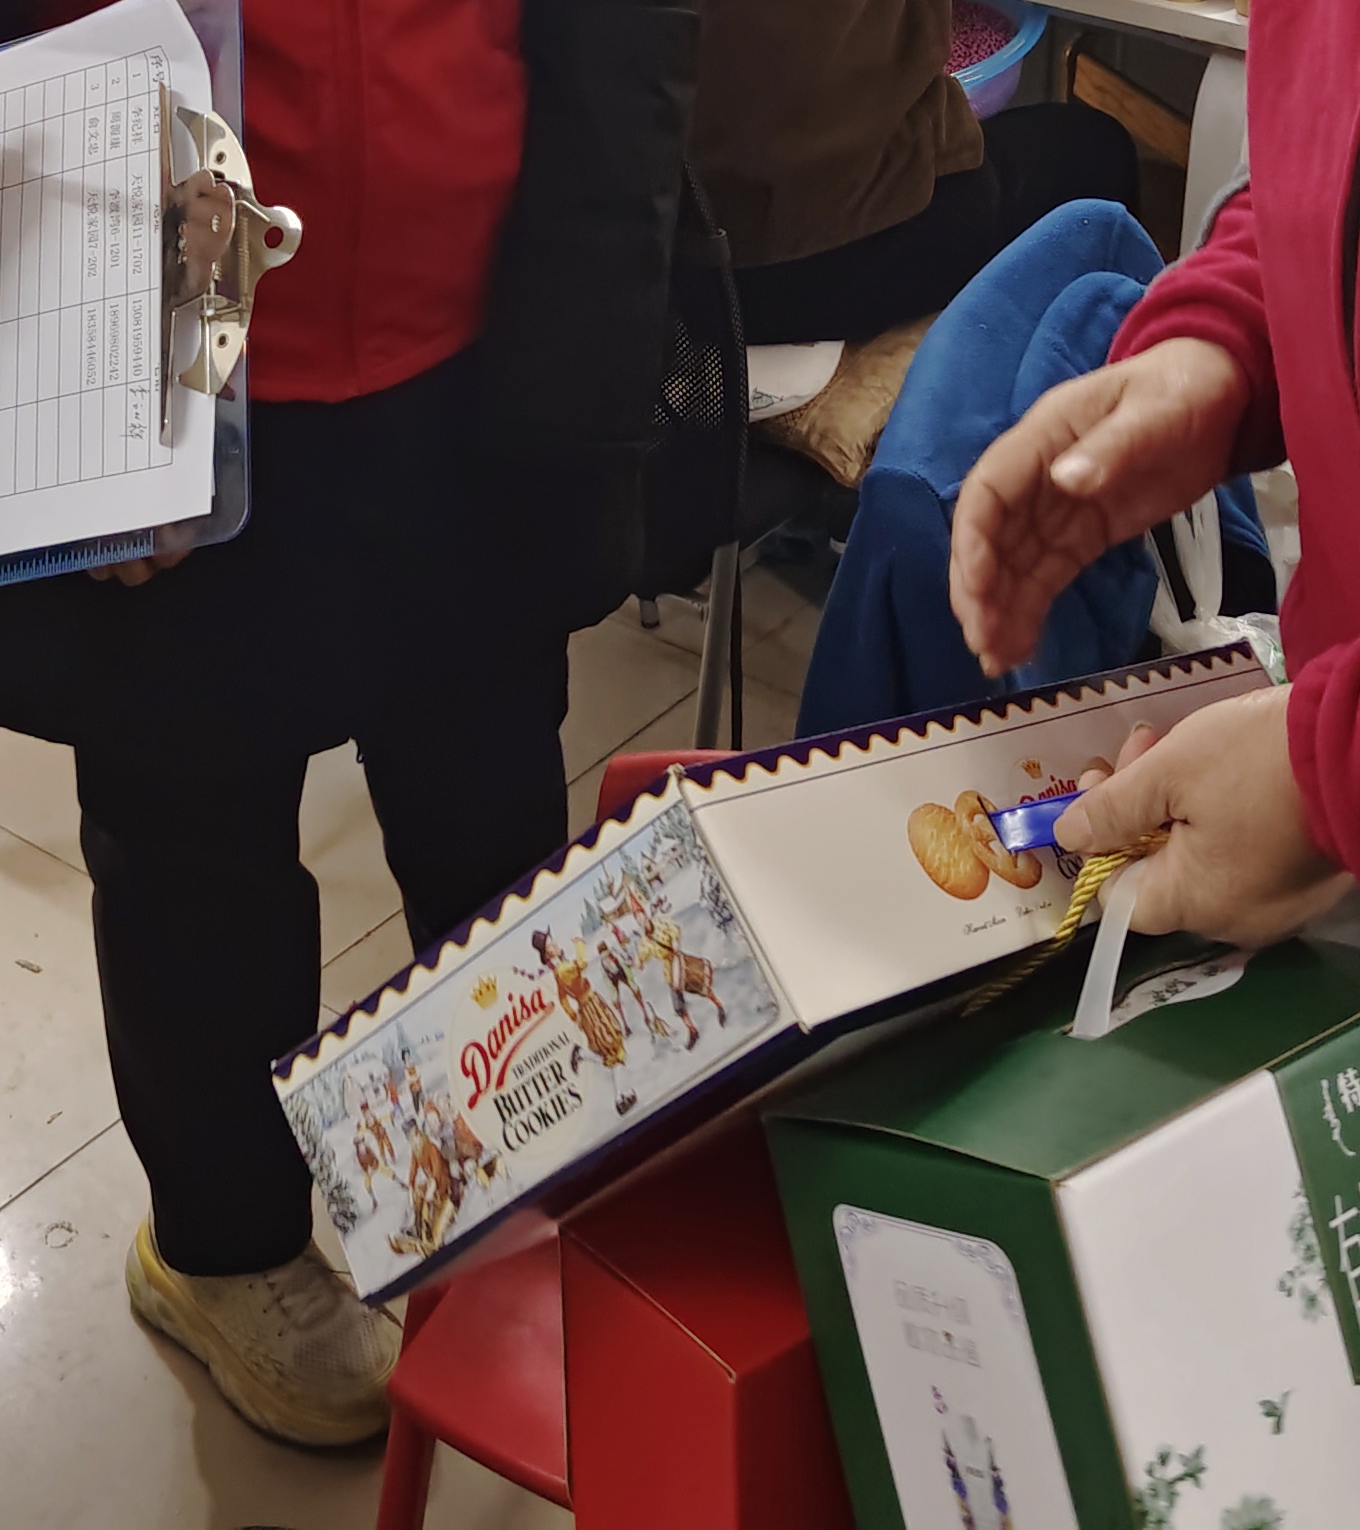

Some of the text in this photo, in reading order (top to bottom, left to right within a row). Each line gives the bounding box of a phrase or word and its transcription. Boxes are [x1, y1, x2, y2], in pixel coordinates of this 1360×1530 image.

[90, 83, 100, 91] 3
[111, 76, 121, 86] 2
[460, 988, 549, 1111] Danisa
[512, 1030, 572, 1081] TRADITIONAL
[492, 1059, 568, 1124] BUTTER
[502, 1082, 584, 1153] COOKIES
